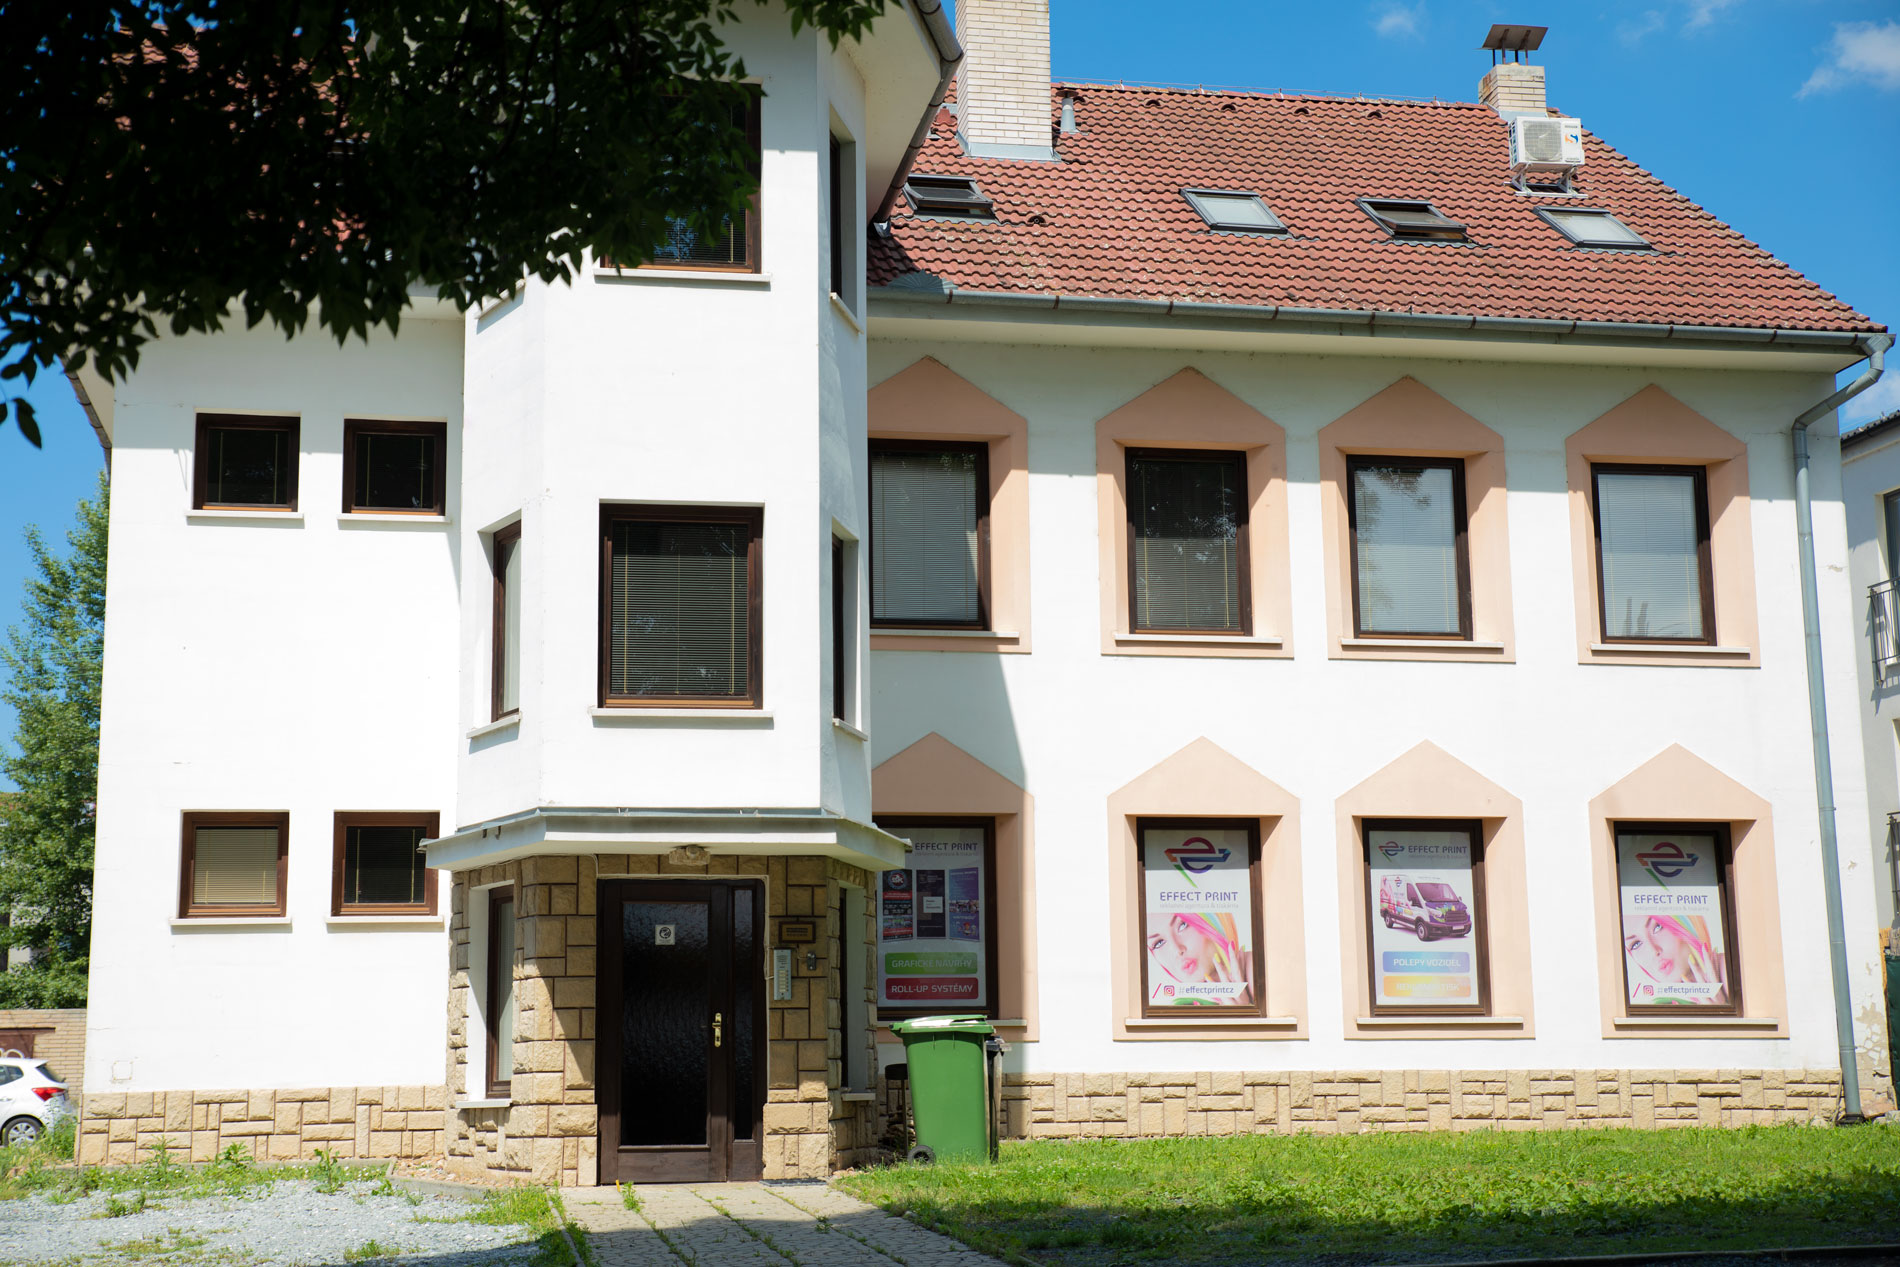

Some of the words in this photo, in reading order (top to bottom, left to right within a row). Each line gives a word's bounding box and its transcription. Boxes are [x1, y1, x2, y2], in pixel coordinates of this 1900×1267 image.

[914, 842, 949, 851] EFFECT
[951, 842, 978, 851] PRINT
[1408, 845, 1440, 854] EFFECT
[1442, 845, 1468, 854] PRINT
[1159, 891, 1201, 902] EFFECT
[1205, 891, 1239, 902] PRINT
[1633, 894, 1673, 904] EFFECT
[1676, 894, 1708, 905] PRINT
[1393, 958, 1425, 967] POLEPY
[891, 985, 929, 993] ROLL-UP
[931, 982, 974, 993] SYSTÉMY
